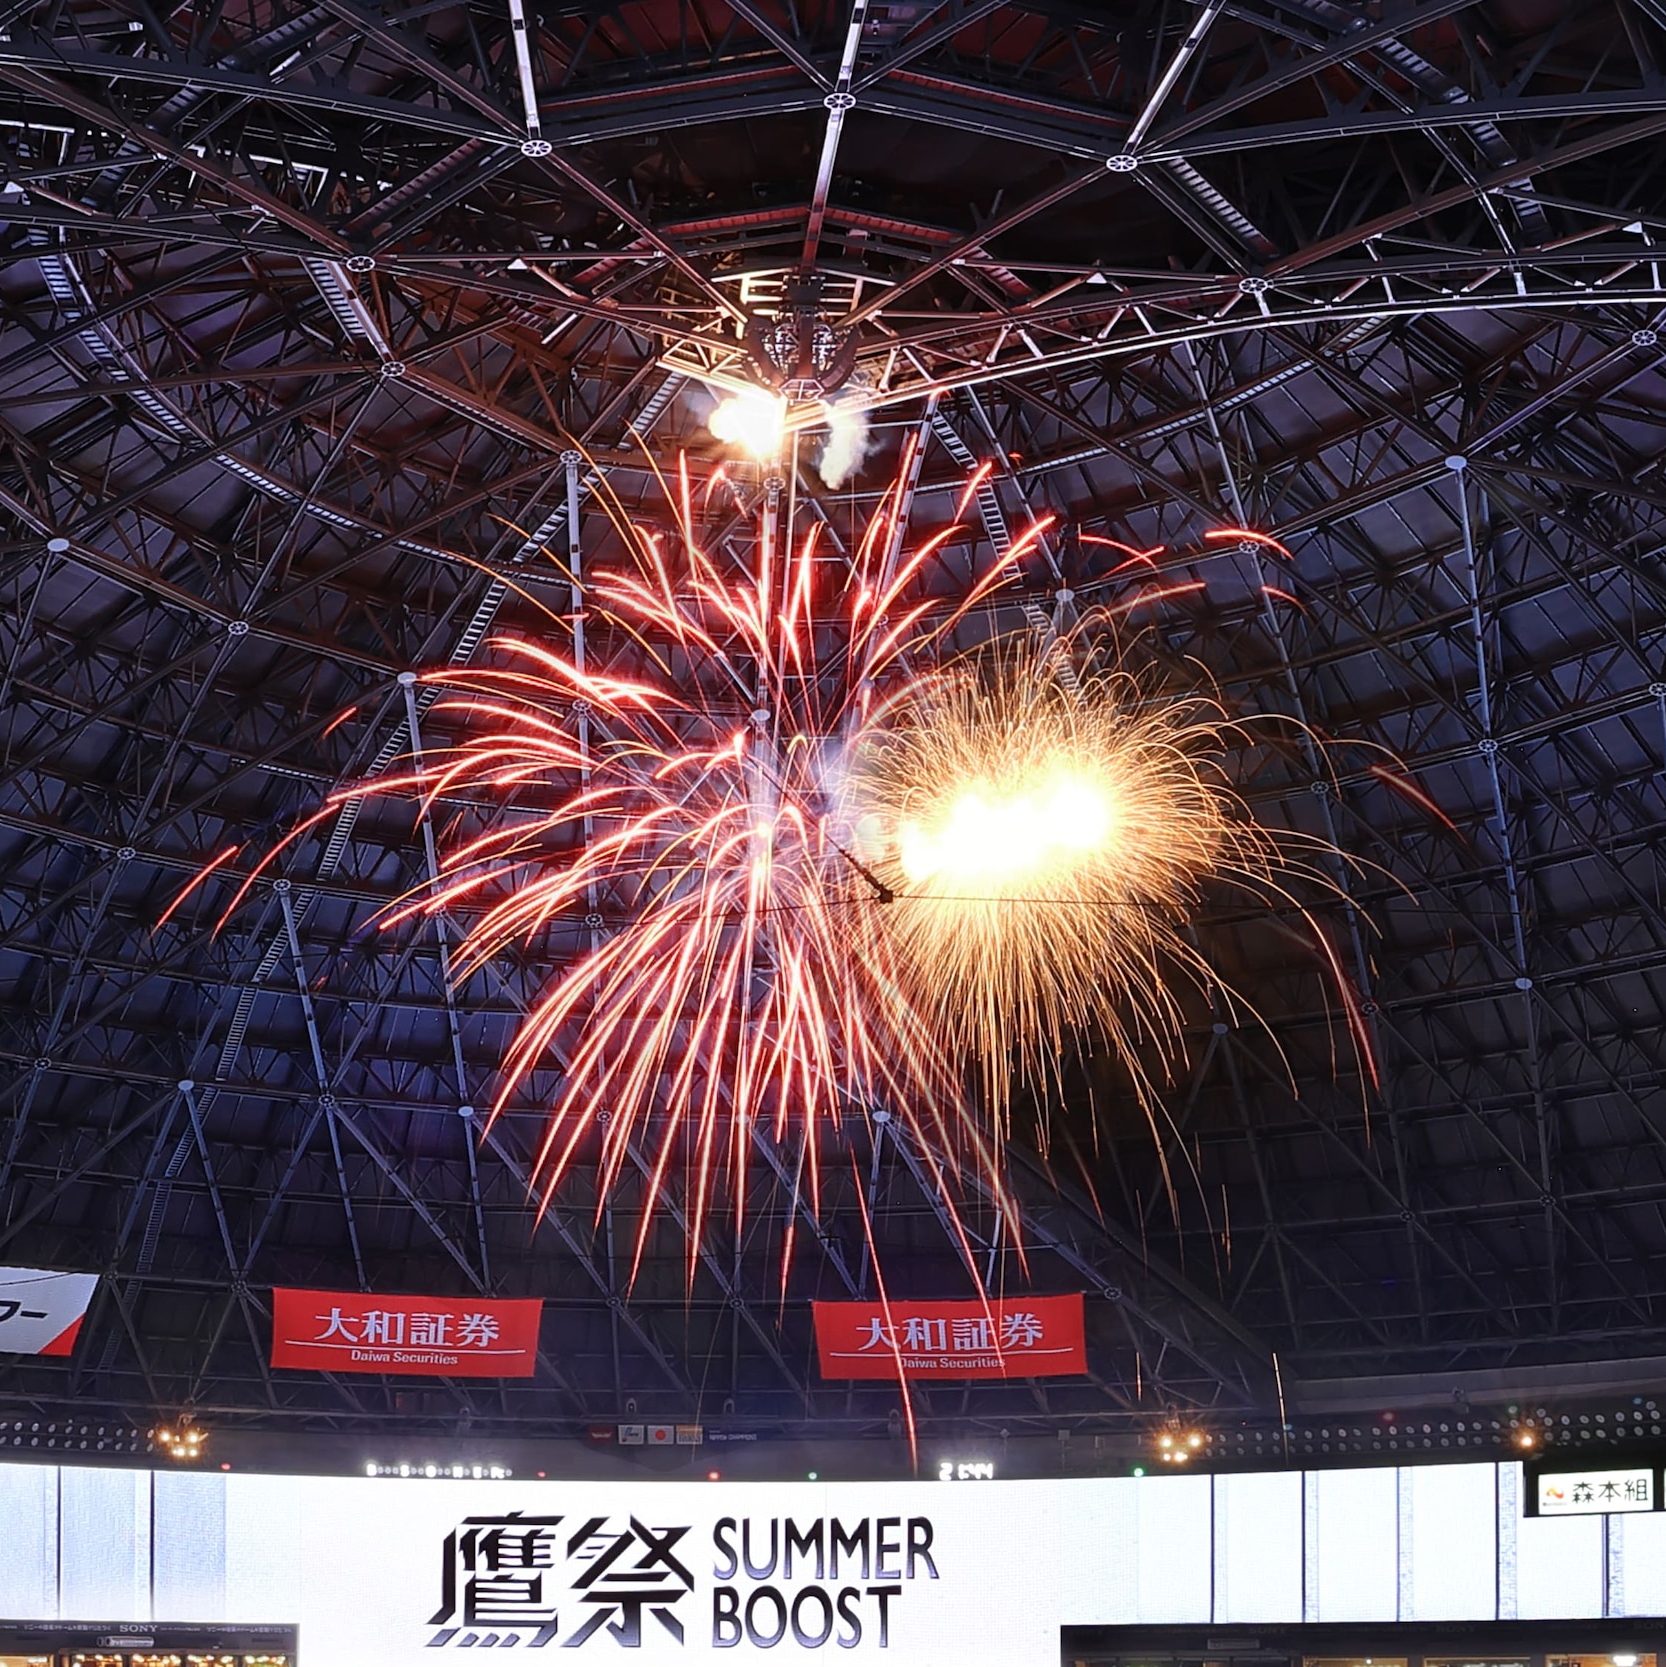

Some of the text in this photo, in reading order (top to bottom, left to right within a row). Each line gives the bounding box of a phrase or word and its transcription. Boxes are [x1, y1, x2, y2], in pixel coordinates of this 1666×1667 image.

[314, 1306, 500, 1348] 大和証券
[856, 1313, 1044, 1352] 大和証券
[351, 1349, 458, 1366] Daiwa Securities
[899, 1356, 1006, 1369] Daiwa Securities
[1571, 1478, 1647, 1504] 森本組
[712, 1516, 940, 1580] SUMMER
[425, 1510, 696, 1649] 鷹祭
[119, 1624, 158, 1633] SONY
[712, 1585, 902, 1649] BOOST
